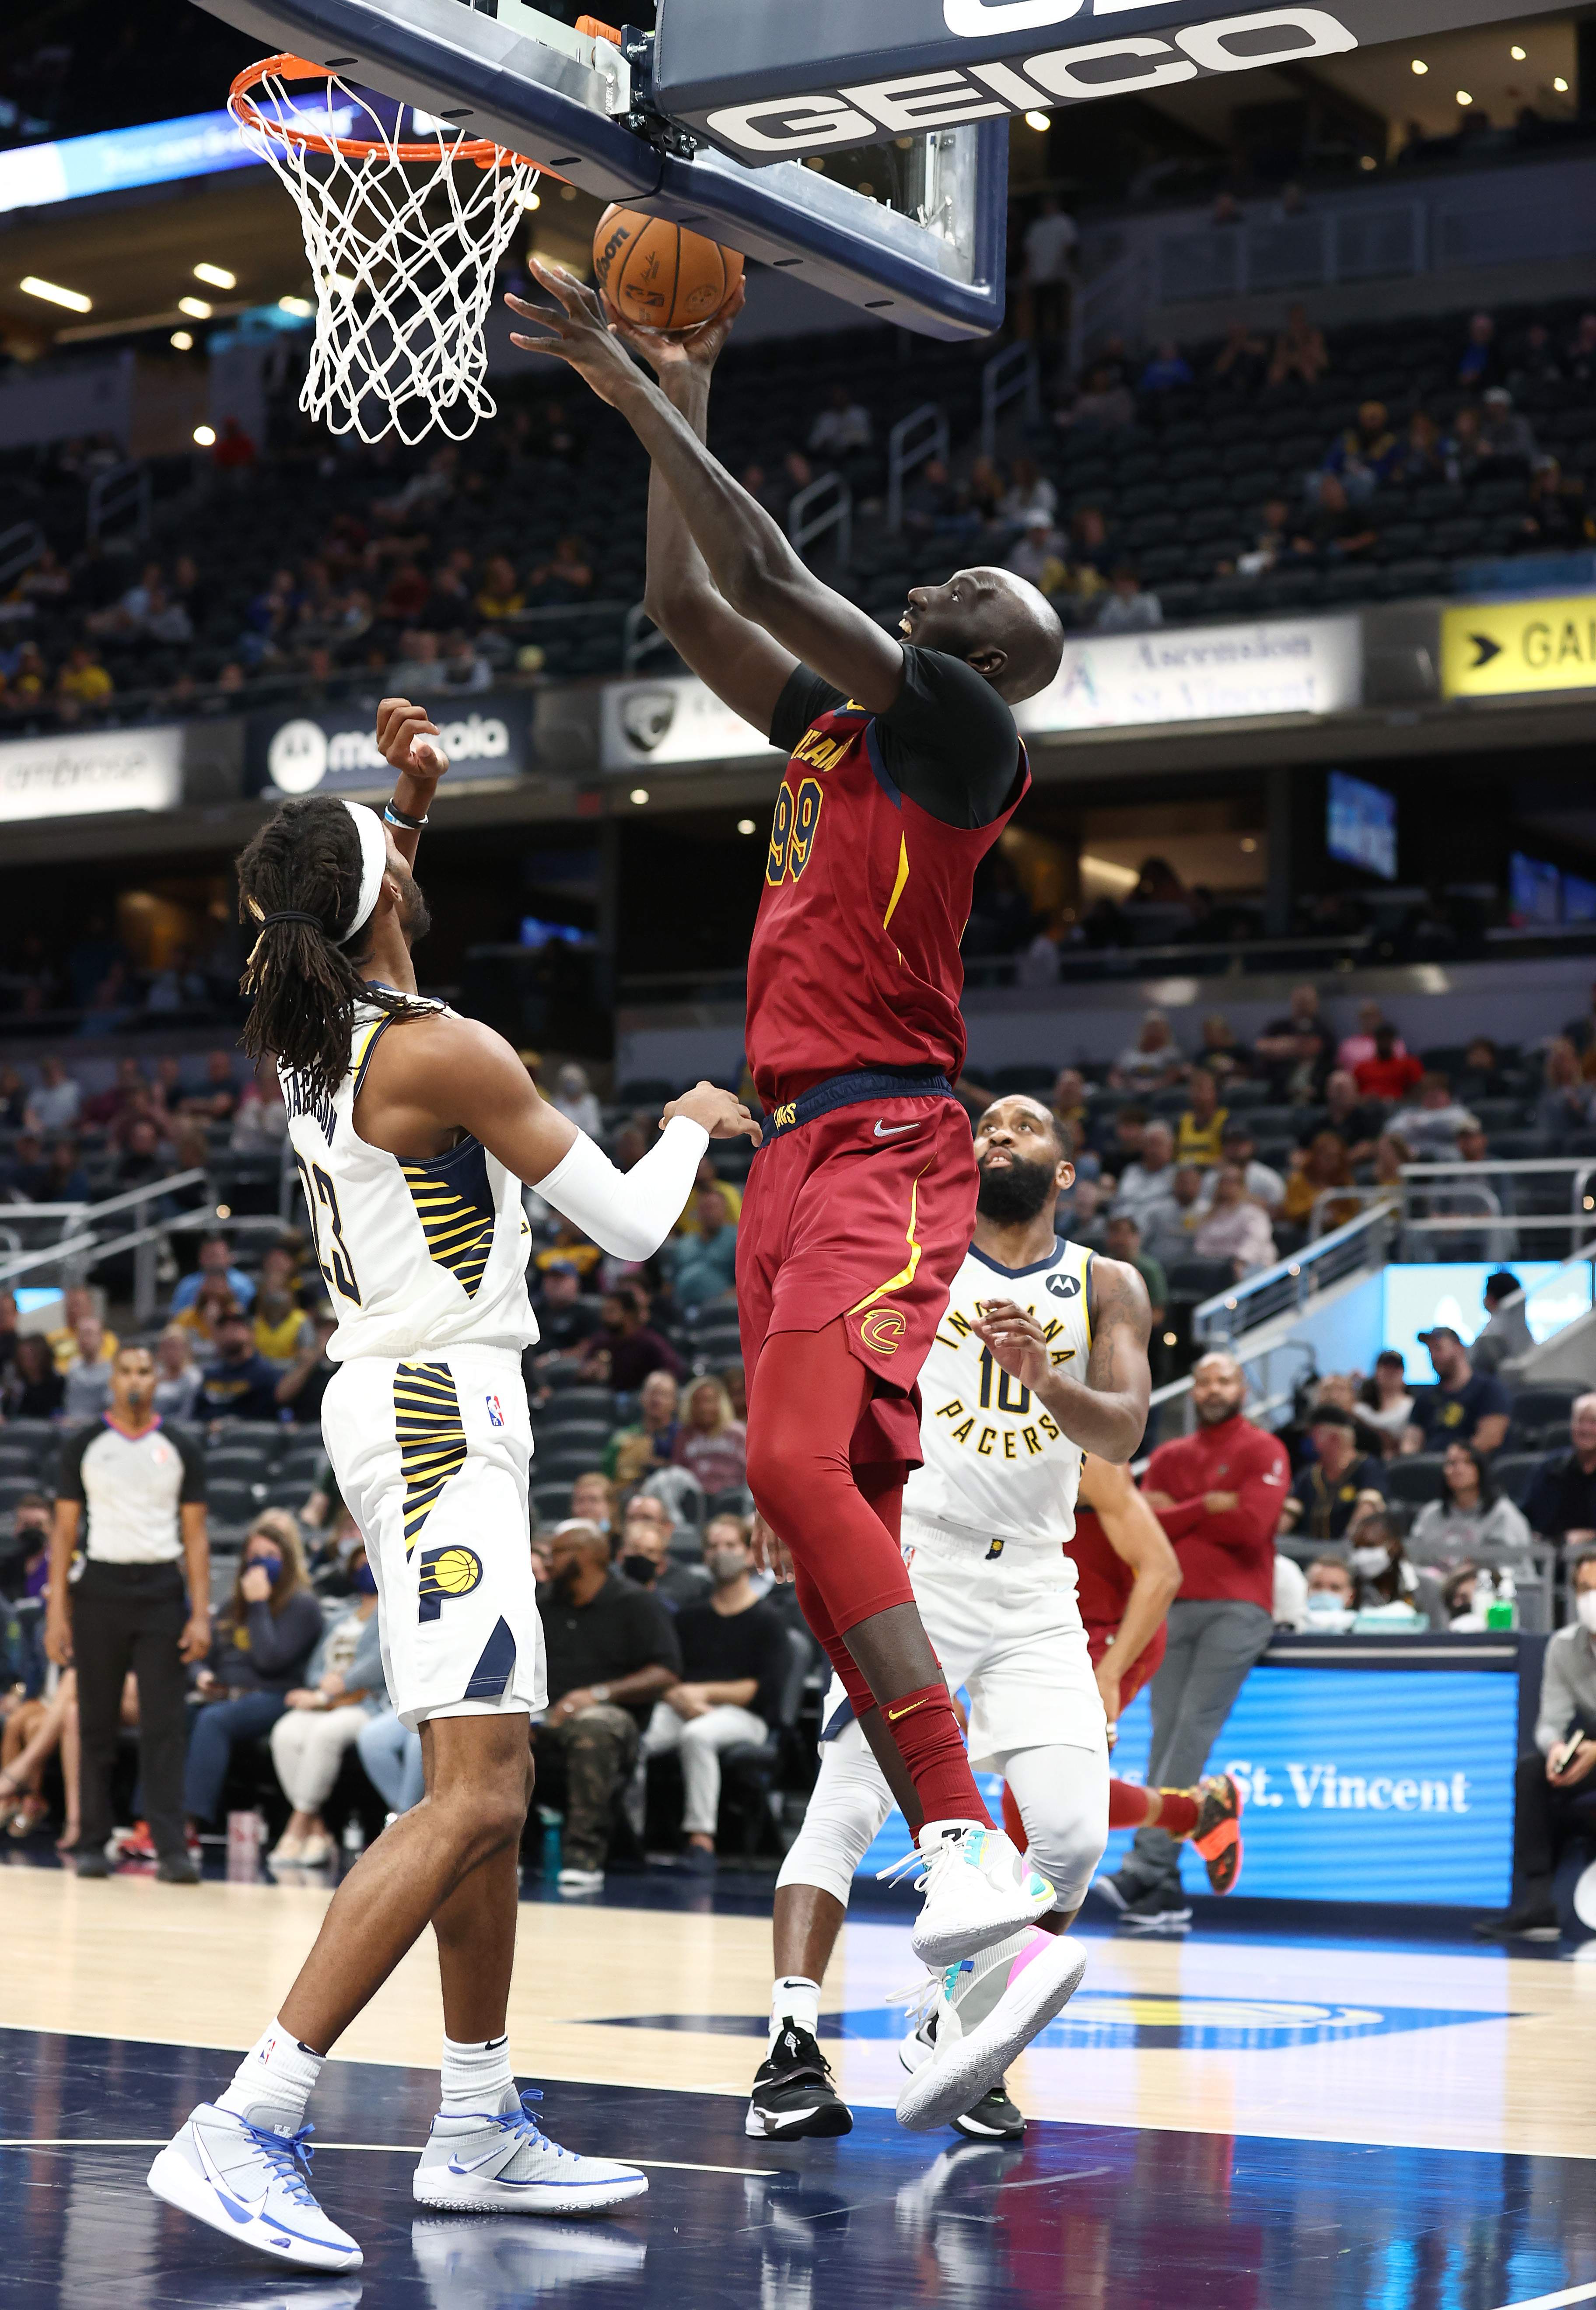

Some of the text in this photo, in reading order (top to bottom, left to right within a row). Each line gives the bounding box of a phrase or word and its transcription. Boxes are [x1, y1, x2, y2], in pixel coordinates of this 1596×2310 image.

[706, 9, 1359, 152] GEICO
[766, 777, 823, 886] 99
[934, 1301, 1076, 1367] INNA
[978, 1343, 1032, 1416] 10
[935, 1400, 1060, 1459] PACERS
[1225, 1760, 1472, 1814] St. Vincent
